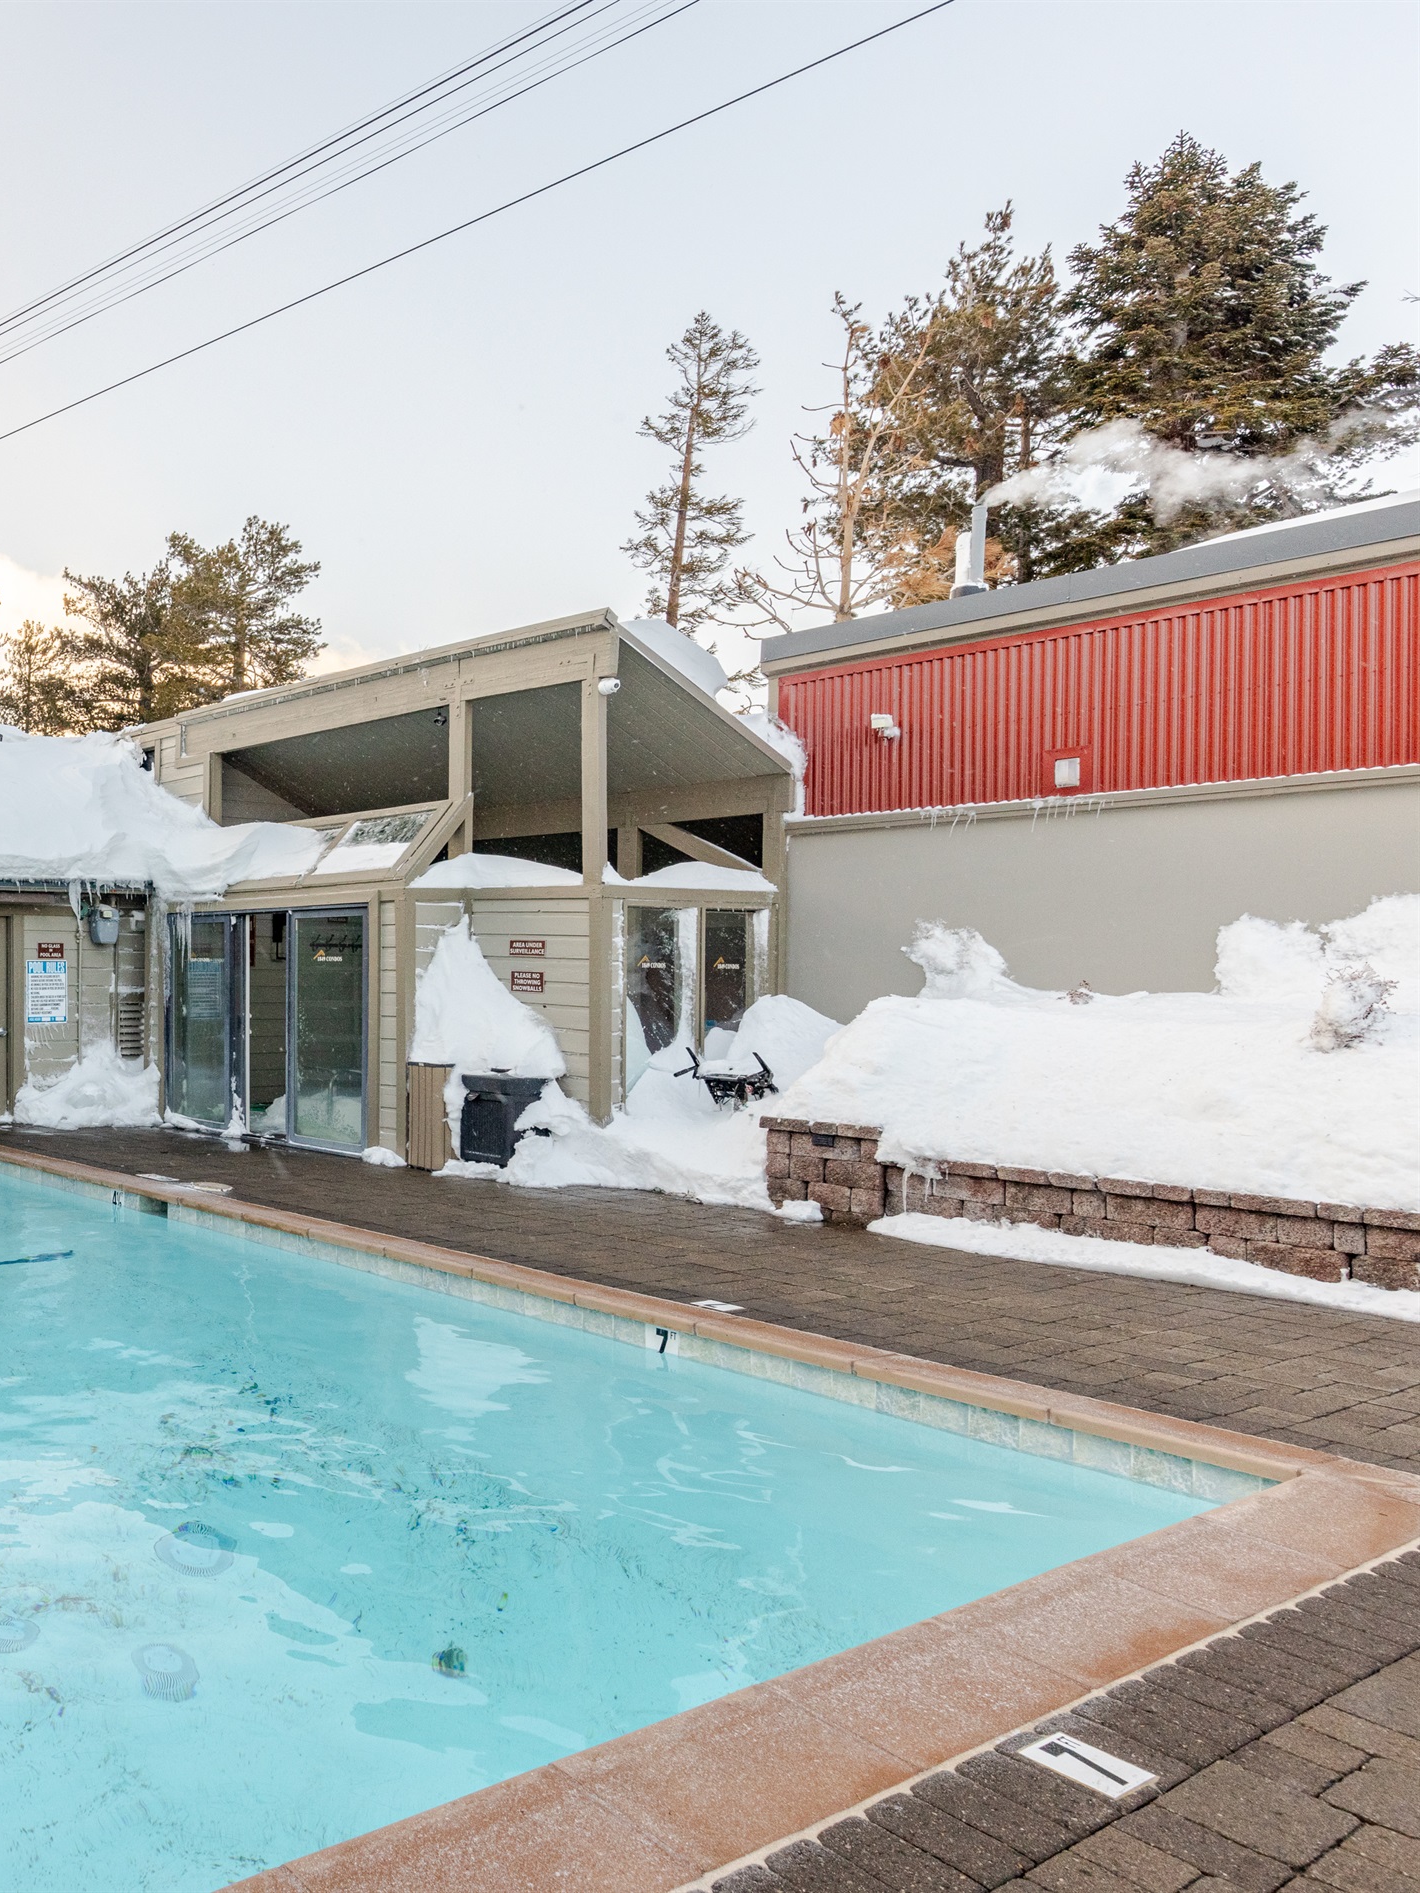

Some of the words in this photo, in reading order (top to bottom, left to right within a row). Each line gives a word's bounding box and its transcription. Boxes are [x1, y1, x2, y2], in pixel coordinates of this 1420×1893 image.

[29, 962, 45, 973] POOL
[46, 962, 65, 974] RULES
[656, 1328, 668, 1353] 7
[670, 1331, 677, 1340] FT
[1039, 1741, 1128, 1786] 7
